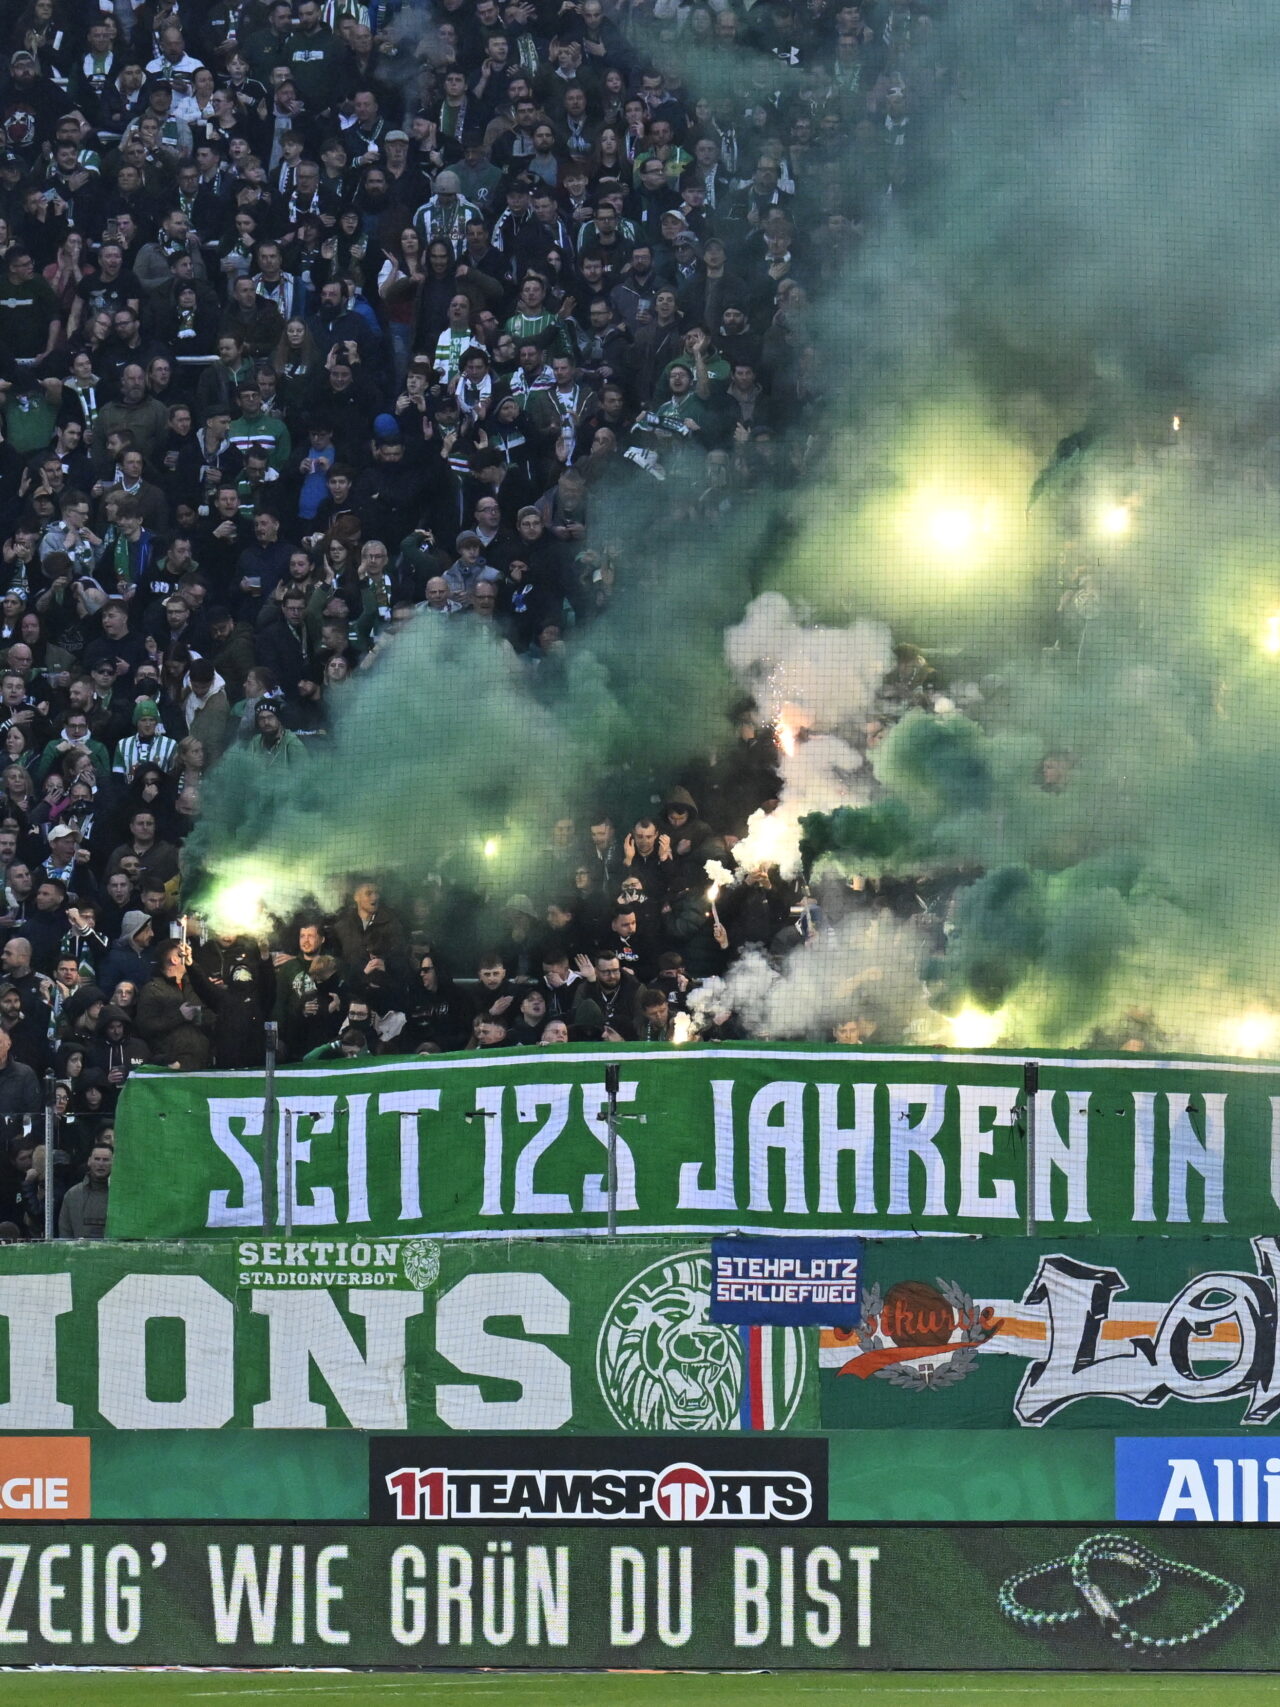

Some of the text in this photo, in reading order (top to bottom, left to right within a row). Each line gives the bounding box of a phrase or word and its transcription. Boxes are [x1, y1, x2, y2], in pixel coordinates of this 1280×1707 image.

[205, 1089, 441, 1227] SEIT
[476, 1081, 640, 1215] 125
[676, 1079, 1092, 1222] JAHREN
[1131, 1092, 1229, 1223] IN
[238, 1242, 400, 1266] SEKTION
[716, 1256, 858, 1279] STEHPLATZ
[239, 1272, 398, 1286] STADIONVERBOT
[716, 1284, 856, 1303] SCHLUEFWEG
[0, 1272, 571, 1430] IONS
[0, 1477, 68, 1509] GIE
[207, 1544, 351, 1645] WIE
[390, 1541, 569, 1646] GRÜN
[610, 1546, 692, 1648] DU
[734, 1546, 879, 1648] BIST
